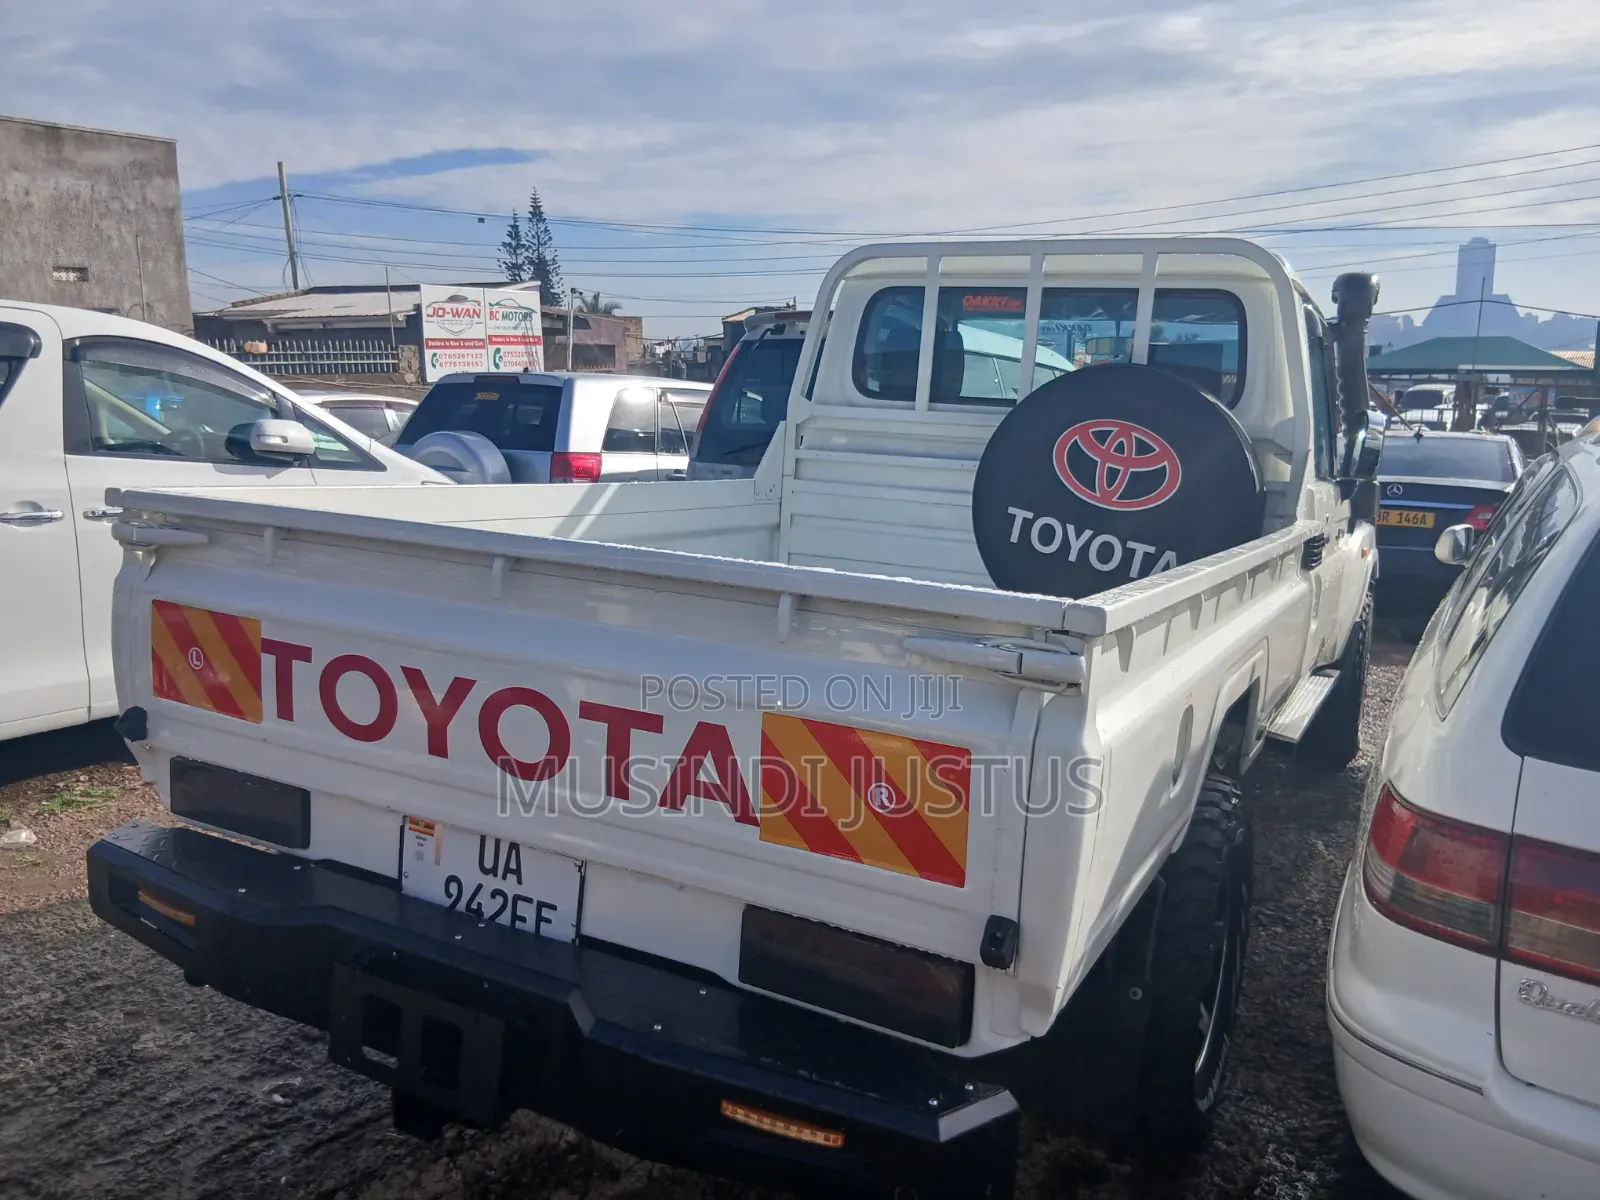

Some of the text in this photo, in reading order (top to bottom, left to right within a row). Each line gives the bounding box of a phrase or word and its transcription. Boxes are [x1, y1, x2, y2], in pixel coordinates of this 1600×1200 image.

[426, 307, 481, 319] JO-WAN
[489, 310, 533, 322] BC MOTORS
[1396, 511, 1427, 526] 146A
[261, 637, 760, 828] TOYOTA
[478, 834, 523, 885] UA
